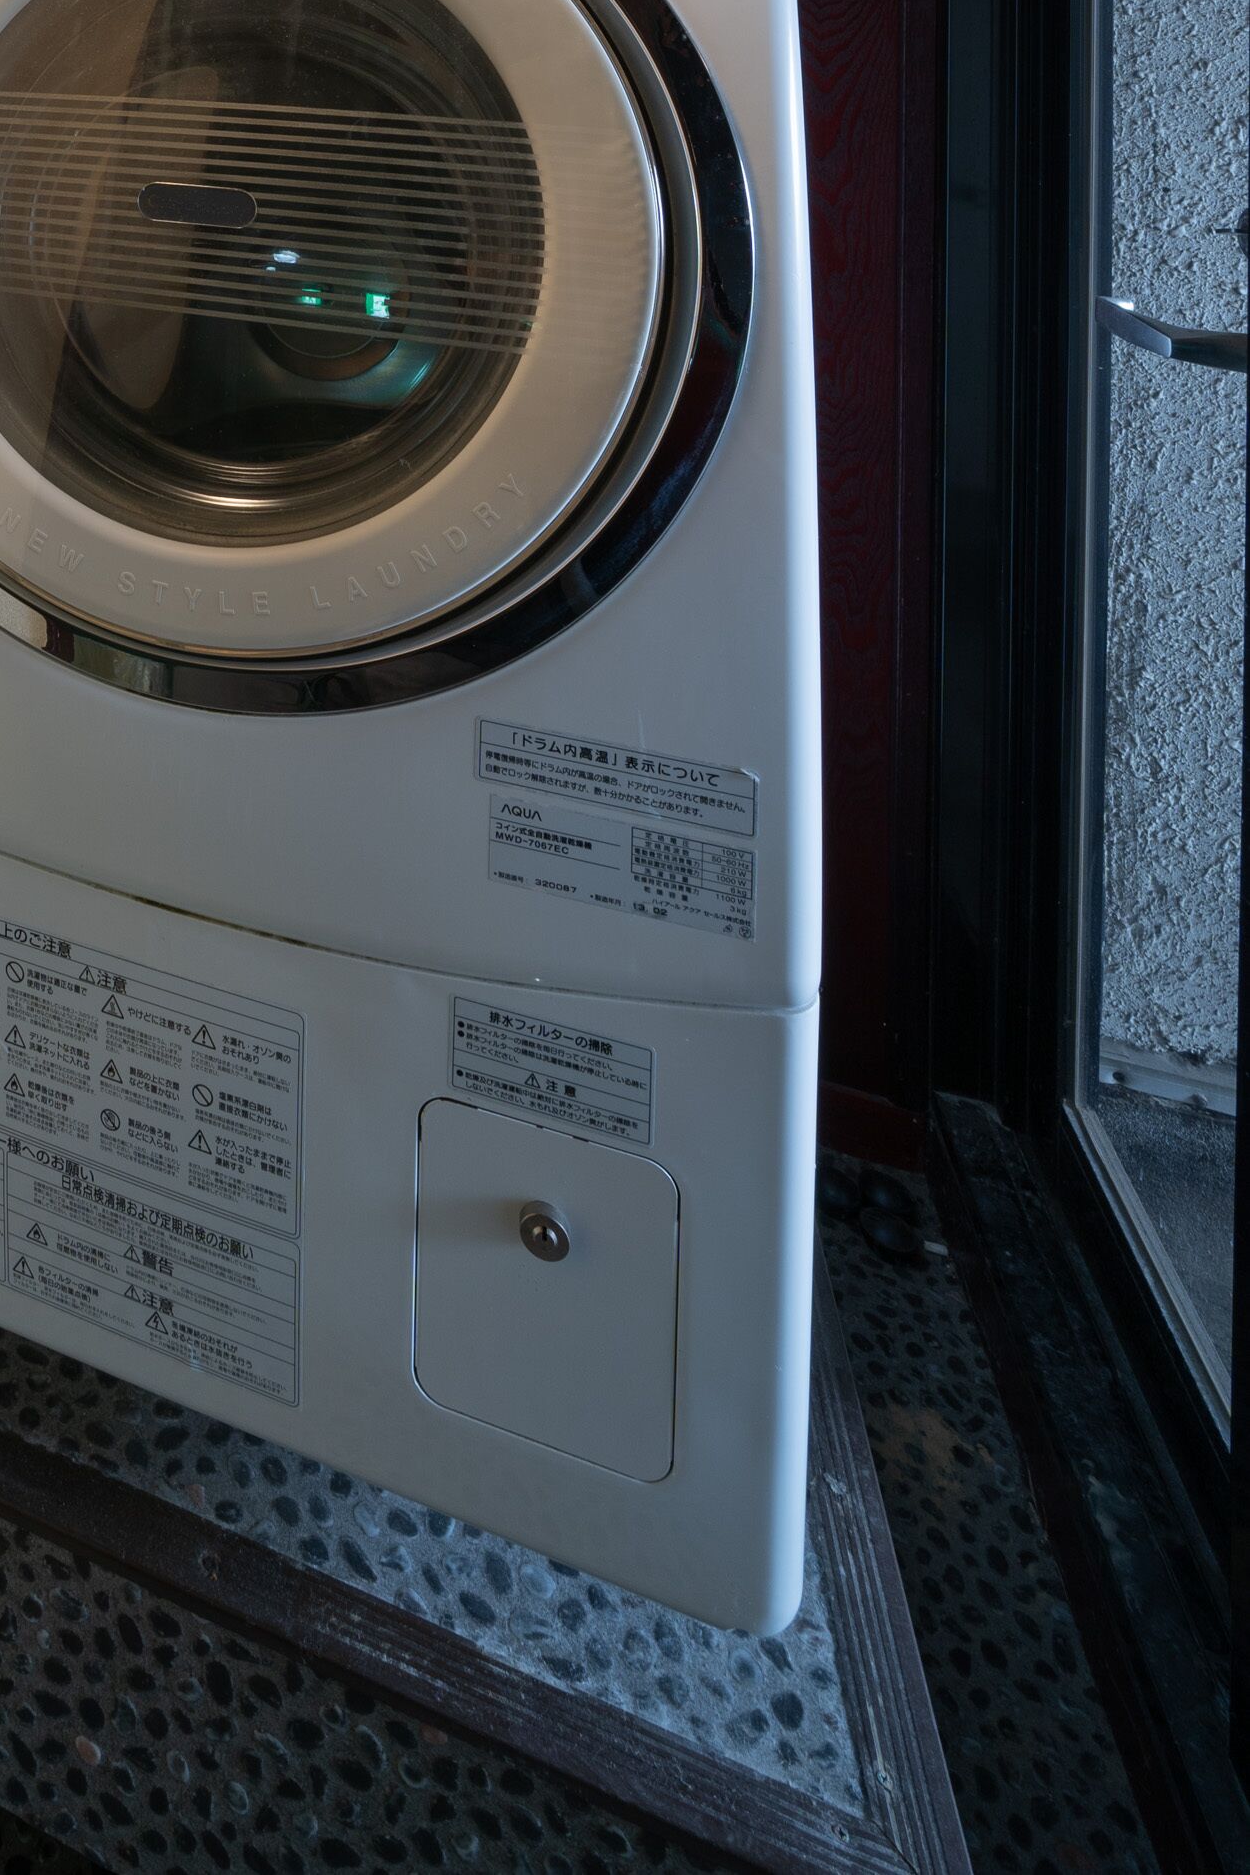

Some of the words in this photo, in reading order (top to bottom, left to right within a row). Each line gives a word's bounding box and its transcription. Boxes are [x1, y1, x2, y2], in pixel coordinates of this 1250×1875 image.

[116, 570, 272, 617] STYLE
[309, 473, 527, 610] LAUNDRY
[512, 732, 720, 787] 「ドラム内高温」表示について
[501, 803, 542, 821] AQUA
[27, 978, 54, 995] 使用する
[97, 970, 127, 995] 注意
[127, 1006, 192, 1037] やけどに注意する
[489, 1011, 613, 1056] 排水フィルターの掃除
[28, 1041, 90, 1070] 洗濯ネットに入れる
[29, 1031, 90, 1060] デリケートな衣類は
[221, 1046, 260, 1066] おそれあり
[546, 1079, 576, 1097] 注意
[127, 1127, 179, 1153] などに入らない
[215, 1135, 291, 1168] 水が入ったままで停止
[61, 1175, 254, 1260] 日常点検清掃および定期点検のお願い
[142, 1251, 175, 1277] 警告
[142, 1291, 175, 1317] 注意
